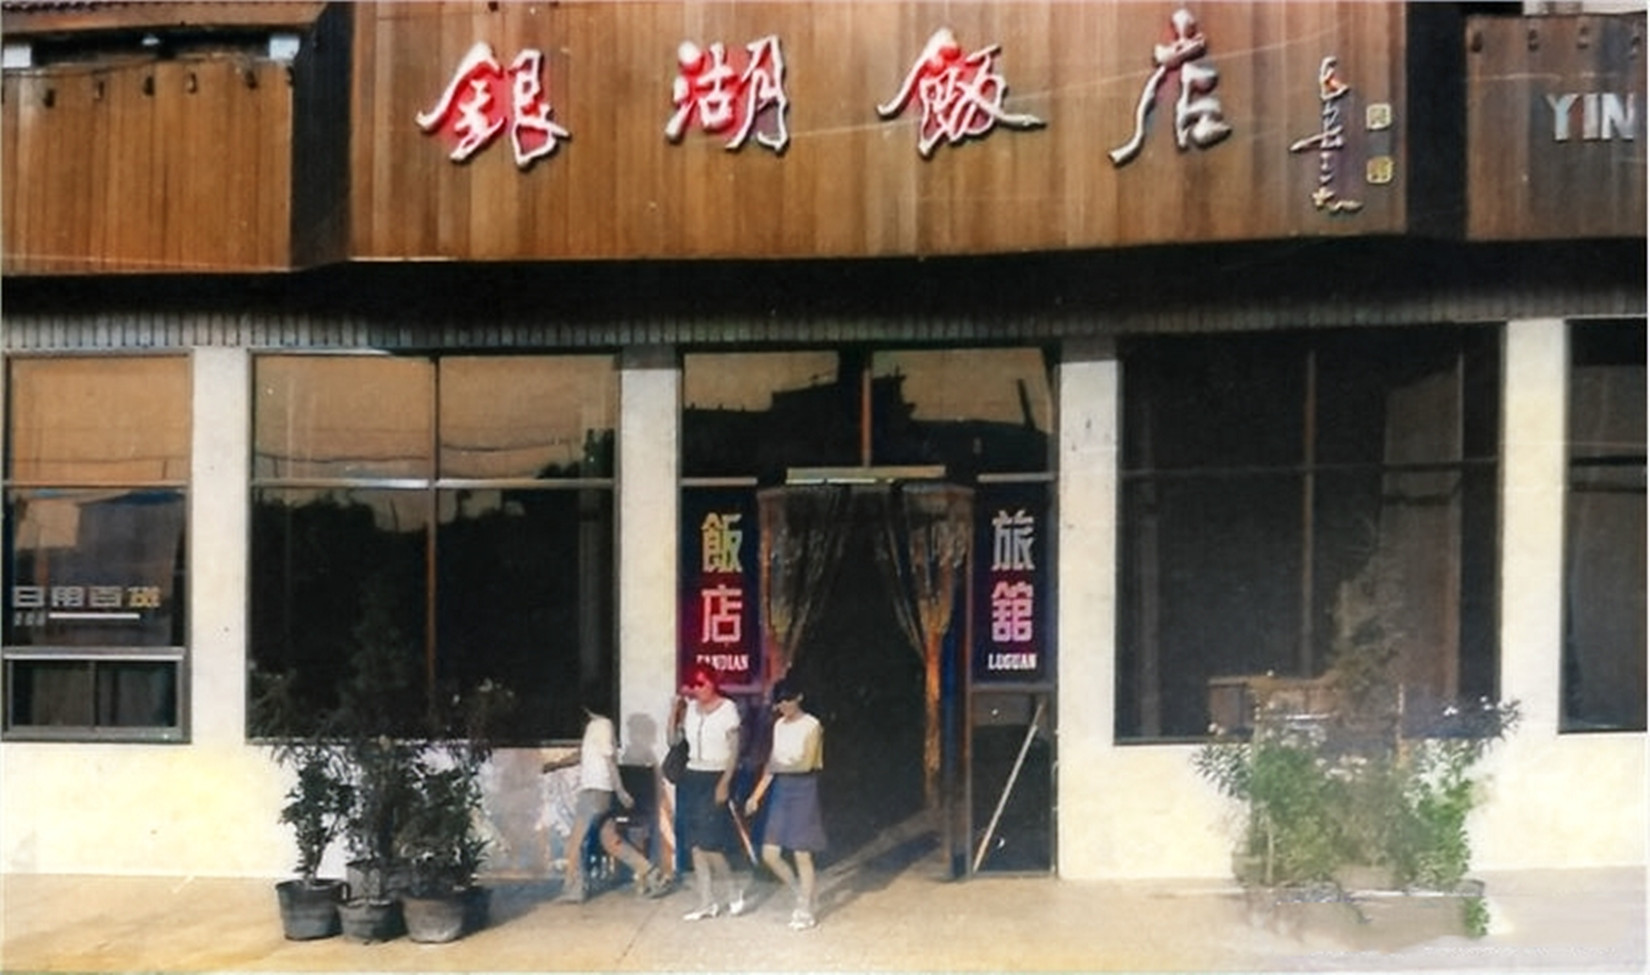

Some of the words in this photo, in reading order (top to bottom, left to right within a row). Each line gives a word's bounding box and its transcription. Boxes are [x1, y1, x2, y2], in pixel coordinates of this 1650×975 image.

[415, 9, 1233, 167] 銀湖飯店
[1544, 92, 1636, 141] YIN
[701, 512, 744, 643] 飯店
